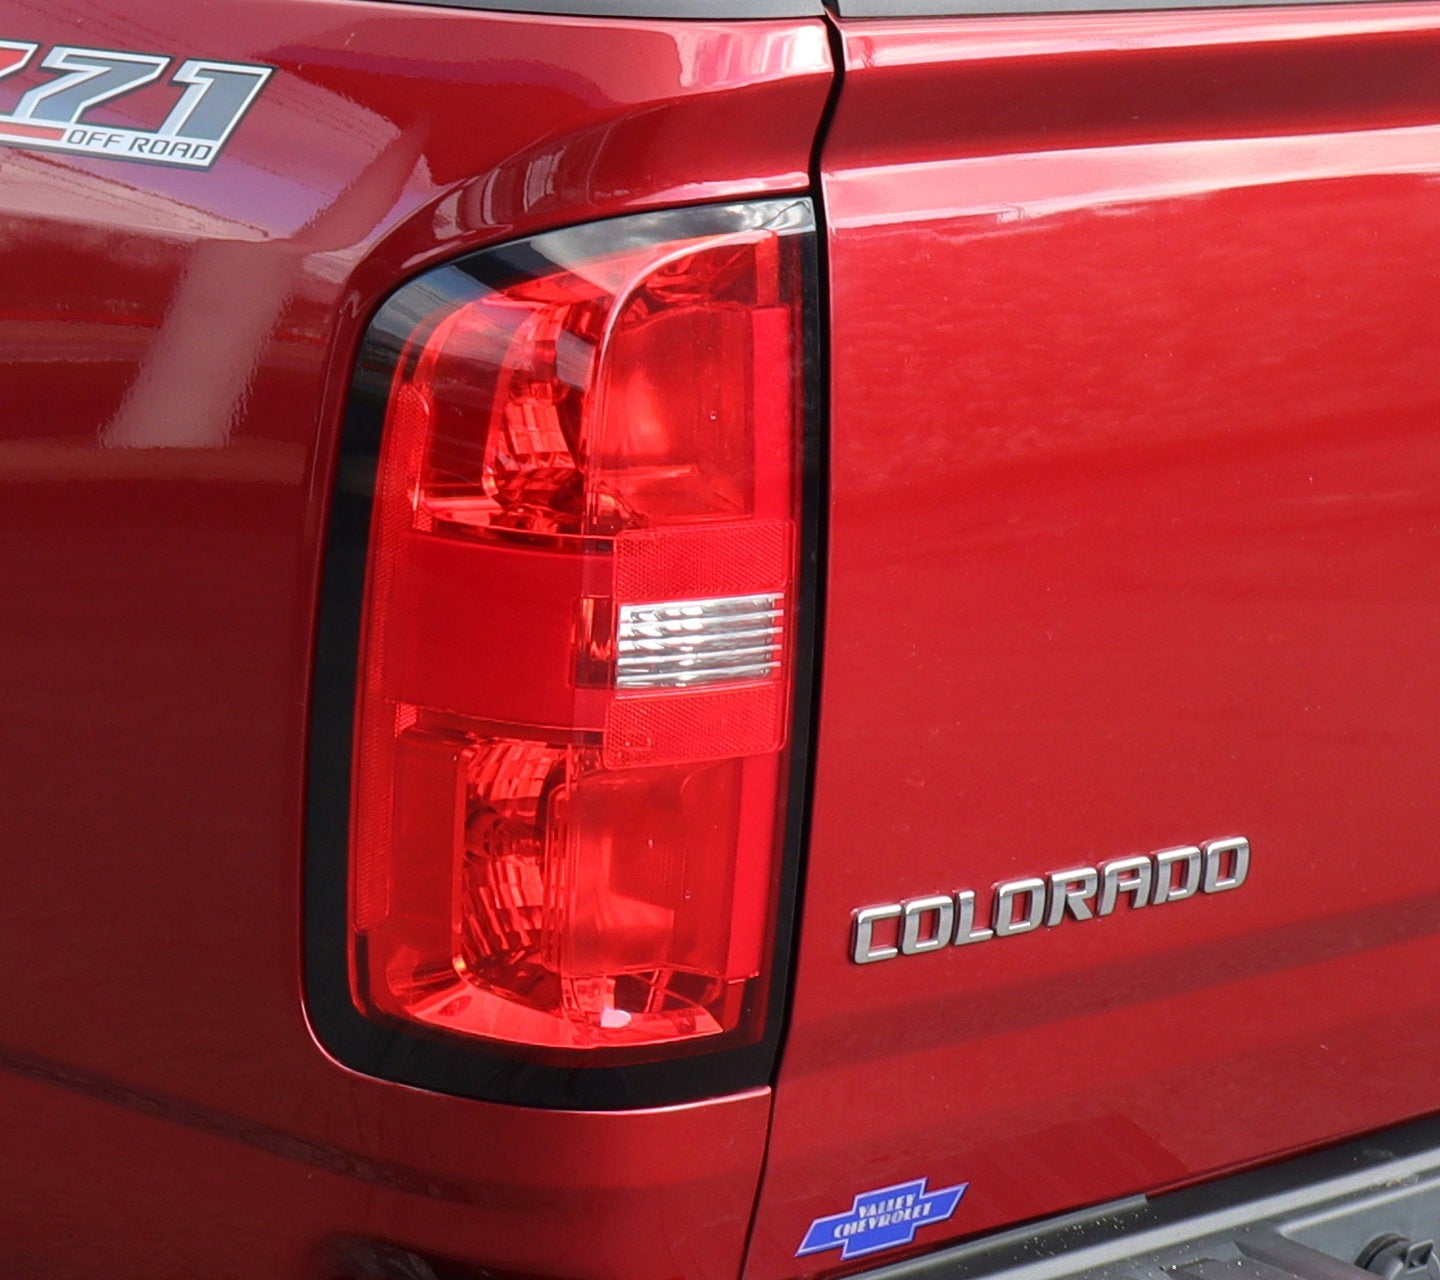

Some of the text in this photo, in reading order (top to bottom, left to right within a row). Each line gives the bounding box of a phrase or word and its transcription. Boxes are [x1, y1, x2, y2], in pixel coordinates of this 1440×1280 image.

[65, 127, 216, 164] OFF ROAD
[848, 835, 1252, 966] COLORADO
[832, 1201, 933, 1241] CHEVROLET
[857, 1192, 918, 1220] VALLEY
